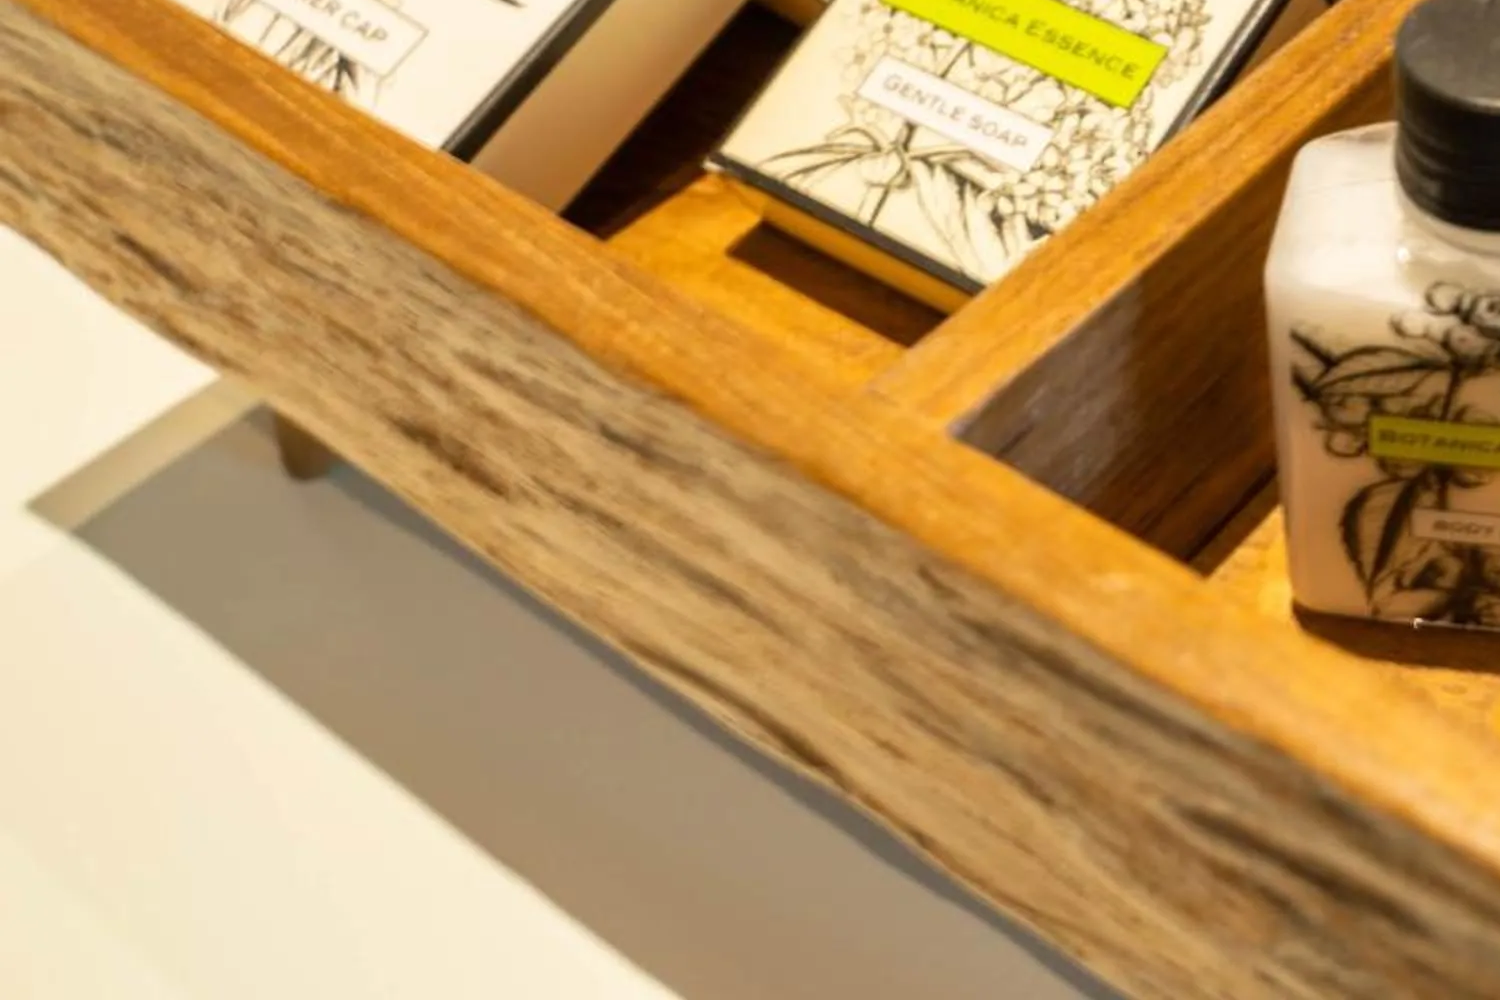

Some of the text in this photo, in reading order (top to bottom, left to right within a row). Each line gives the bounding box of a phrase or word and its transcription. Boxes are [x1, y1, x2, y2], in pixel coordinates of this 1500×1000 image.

[339, 9, 389, 41] CAP
[1025, 18, 1143, 80] ESSENCE
[883, 73, 1028, 149] GENTLE SOAP
[1431, 518, 1495, 538] BODY
